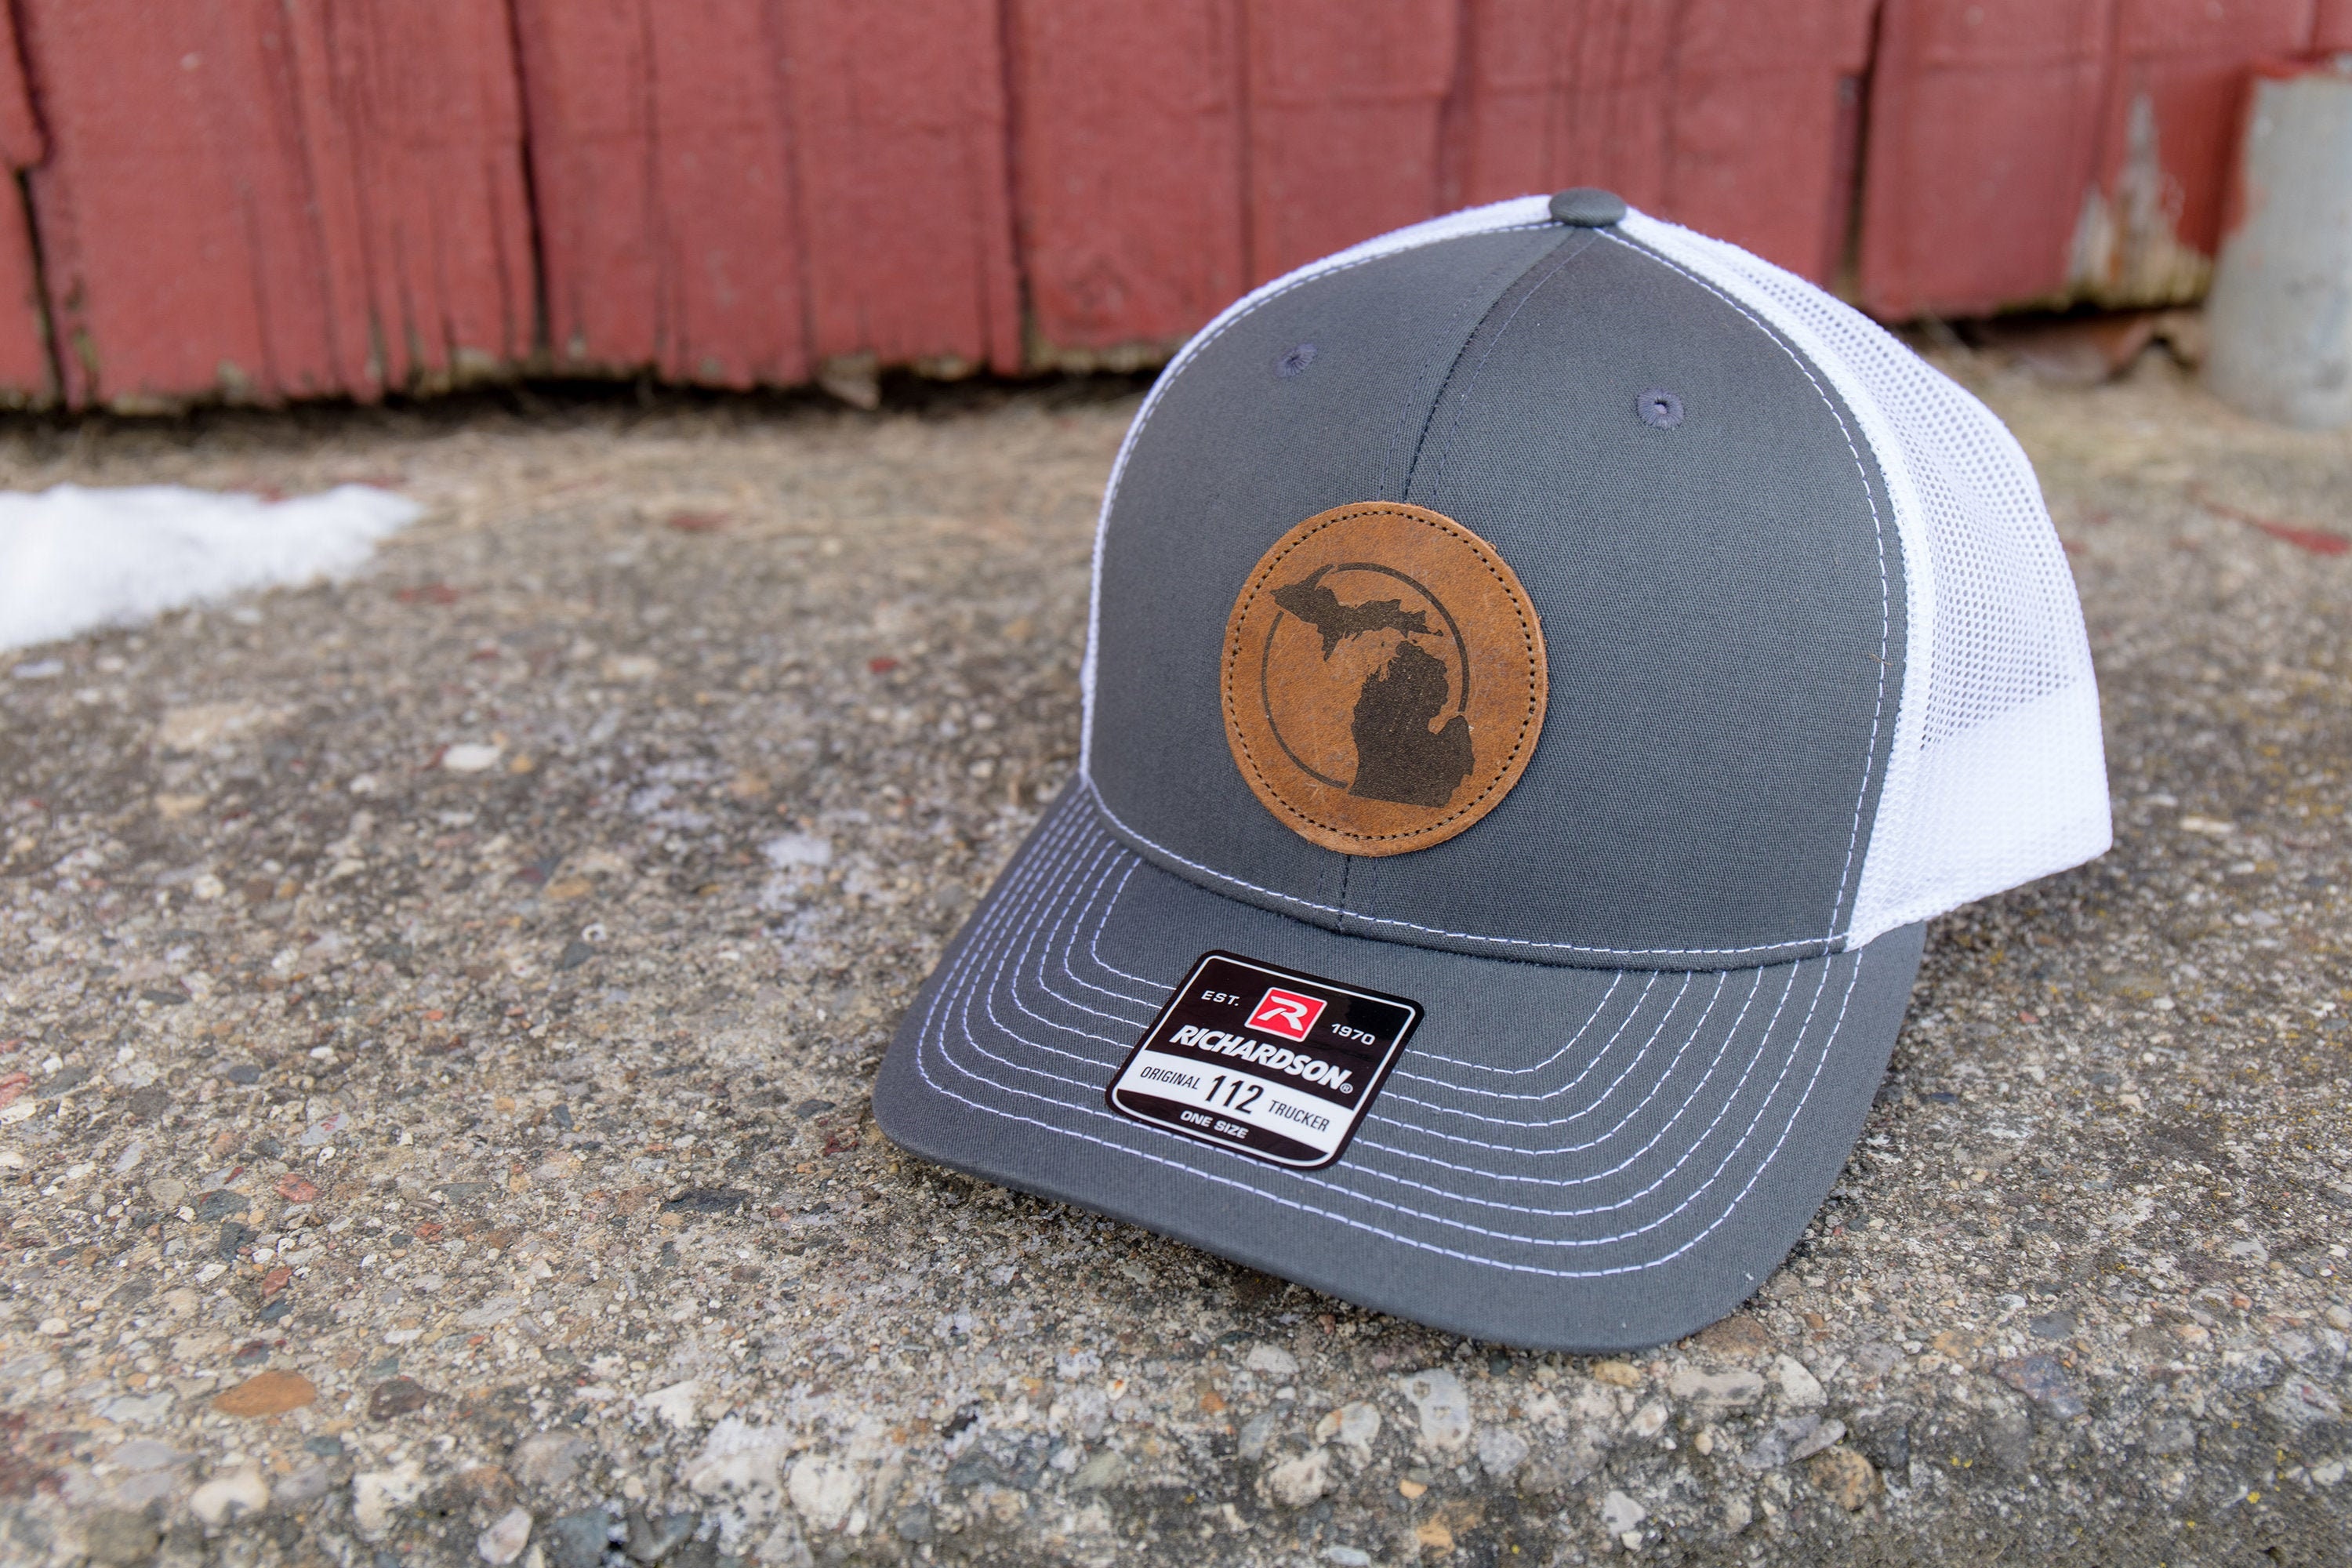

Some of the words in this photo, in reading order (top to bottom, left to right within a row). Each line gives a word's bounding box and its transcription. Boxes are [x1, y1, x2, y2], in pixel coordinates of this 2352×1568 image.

[1201, 990, 1240, 1007] EST.
[1331, 1022, 1376, 1046] 1970
[1257, 995, 1308, 1032] R
[1140, 1066, 1200, 1090] ORIGINAL
[1205, 1075, 1264, 1114] 112
[1268, 1099, 1330, 1132] TRUCKER
[1180, 1109, 1212, 1128] ONE
[1214, 1120, 1250, 1138] SIZE
